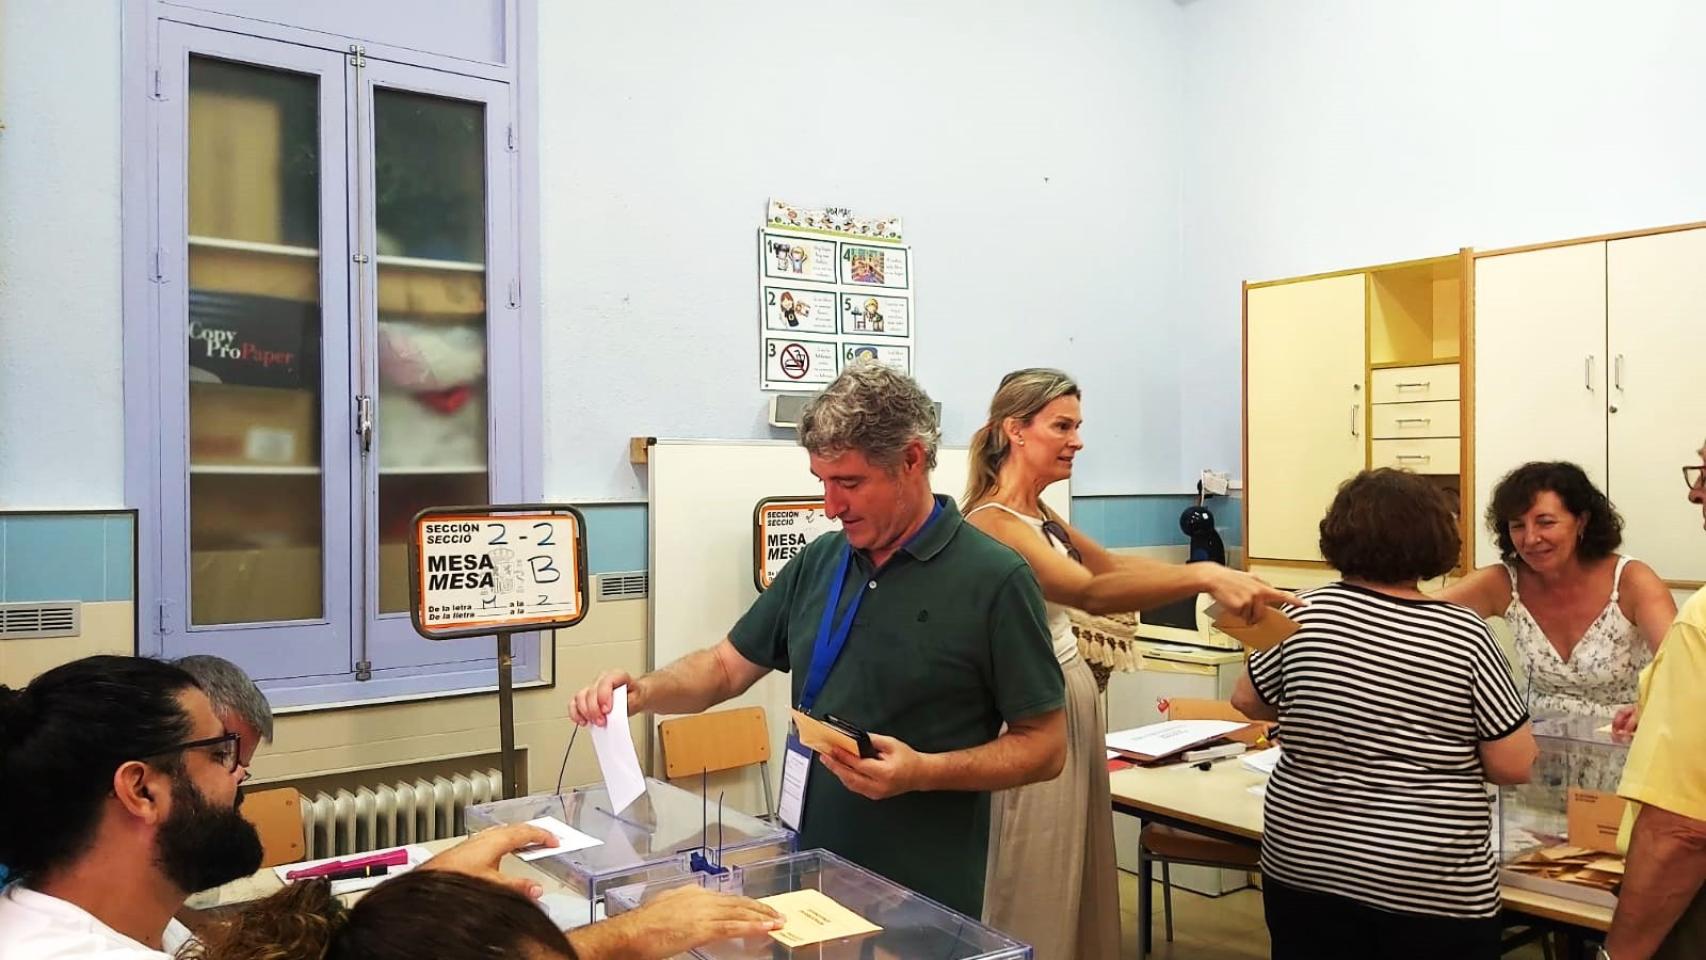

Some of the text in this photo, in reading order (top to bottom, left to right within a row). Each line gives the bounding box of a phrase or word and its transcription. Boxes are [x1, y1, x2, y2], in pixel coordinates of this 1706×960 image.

[767, 239, 772, 253] 1
[843, 249, 851, 262] 4
[768, 291, 776, 306] 2
[844, 298, 852, 312] 5
[189, 321, 237, 346] Copy
[768, 343, 776, 357] 3
[846, 348, 854, 360] 6
[426, 522, 480, 533] SECCIÓN
[767, 533, 807, 546] MESA
[767, 547, 806, 560] MES
[428, 554, 494, 572] MESA
[527, 555, 561, 584] B
[428, 572, 494, 591] MESA
[428, 605, 440, 613] De
[429, 613, 441, 621] De
